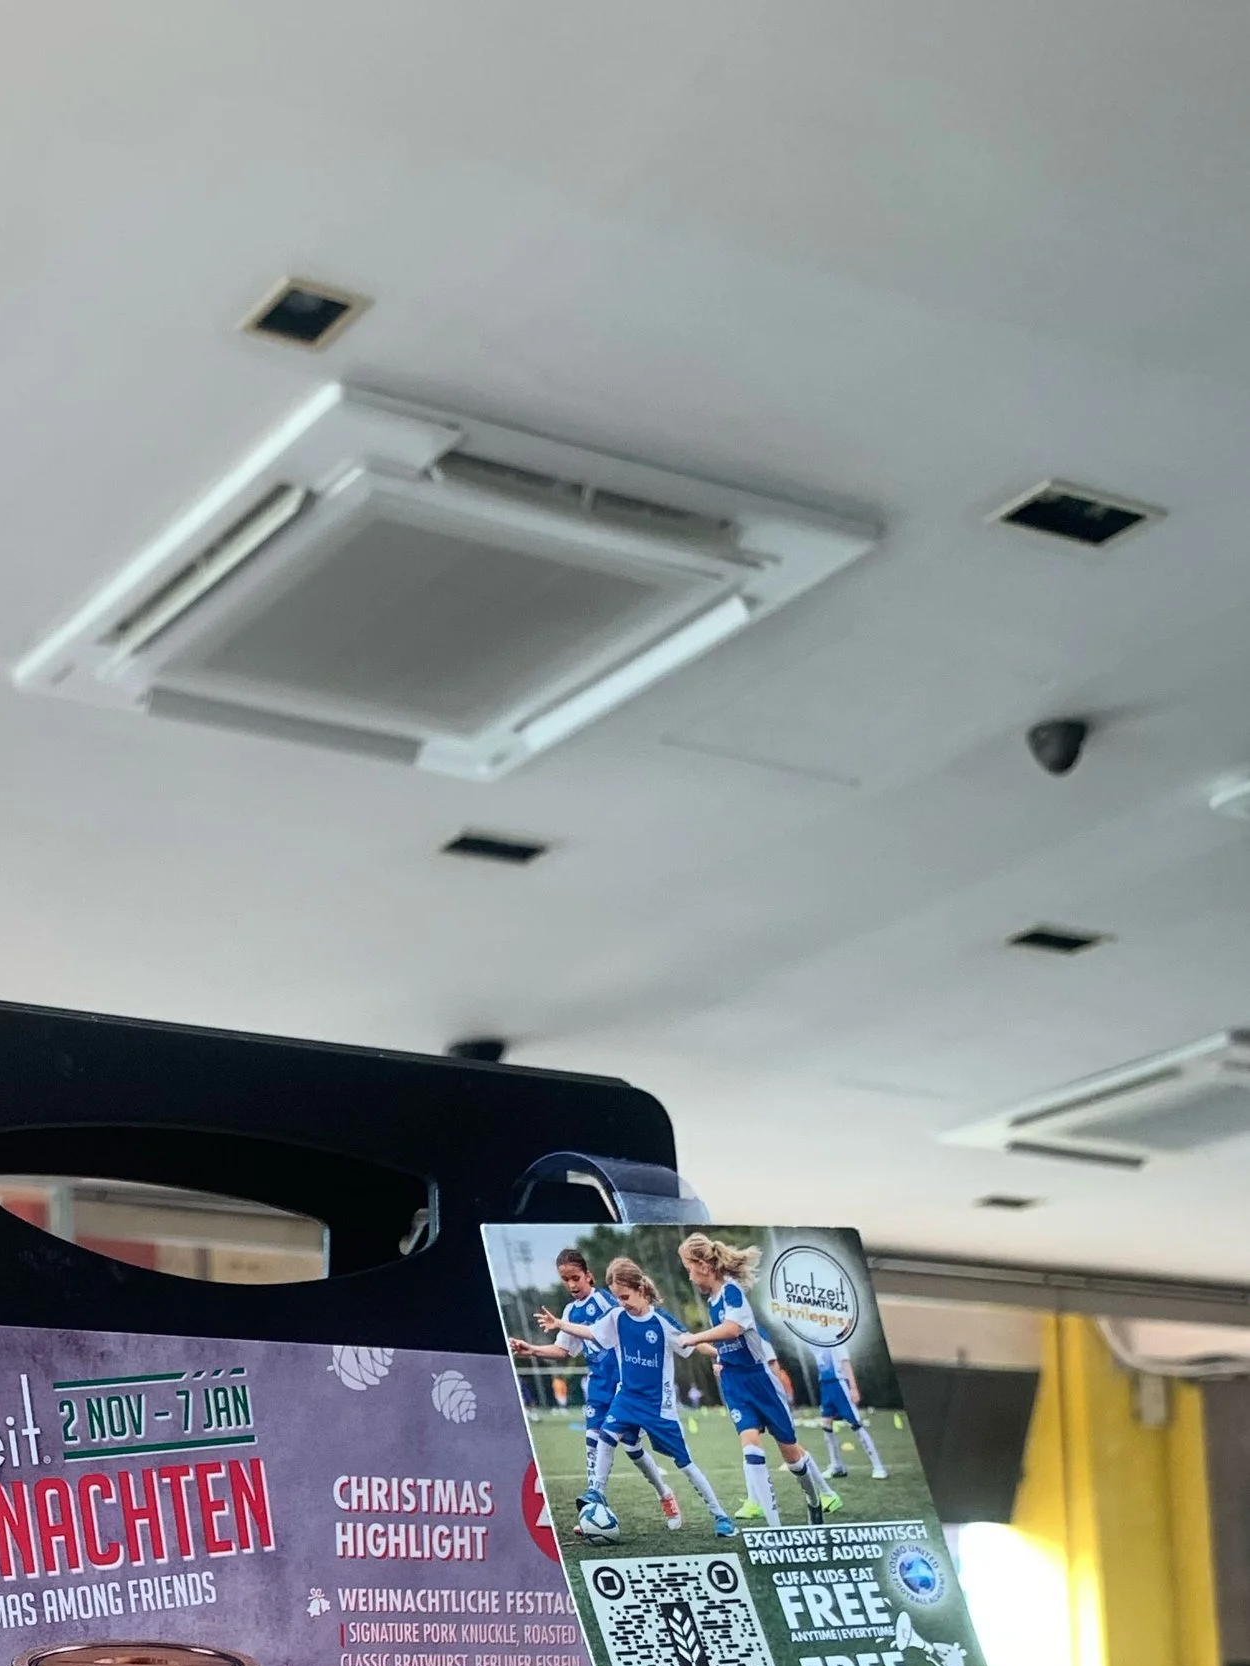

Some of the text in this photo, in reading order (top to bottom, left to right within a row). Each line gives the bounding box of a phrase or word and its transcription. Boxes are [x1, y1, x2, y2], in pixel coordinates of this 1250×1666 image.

[783, 1266, 845, 1302] brotzeit
[786, 1294, 848, 1312] STAMMTISCH
[624, 1347, 659, 1368] brotzeit
[59, 1400, 80, 1444] 2
[86, 1394, 145, 1442] NOV
[176, 1390, 193, 1433] 7
[203, 1385, 253, 1433] JAN
[333, 1475, 494, 1516] CHRISTMAS
[335, 1522, 488, 1561] HIGHLIGHT
[743, 1525, 928, 1548] EXCLUSIVE STAMMTISCH
[749, 1544, 883, 1566] PRIVILEGE ADDED
[772, 1567, 875, 1586] CUFA KIDS EAT
[44, 1582, 122, 1624] AMONG
[127, 1571, 217, 1613] FRIENDS
[338, 1588, 500, 1614] WEIHNACHTLICHE
[776, 1581, 892, 1630] FREE
[350, 1622, 420, 1644] SIGNATURE
[423, 1623, 457, 1644] PORK
[461, 1623, 519, 1647] KNUCKLE,
[524, 1624, 576, 1645] ROASTED
